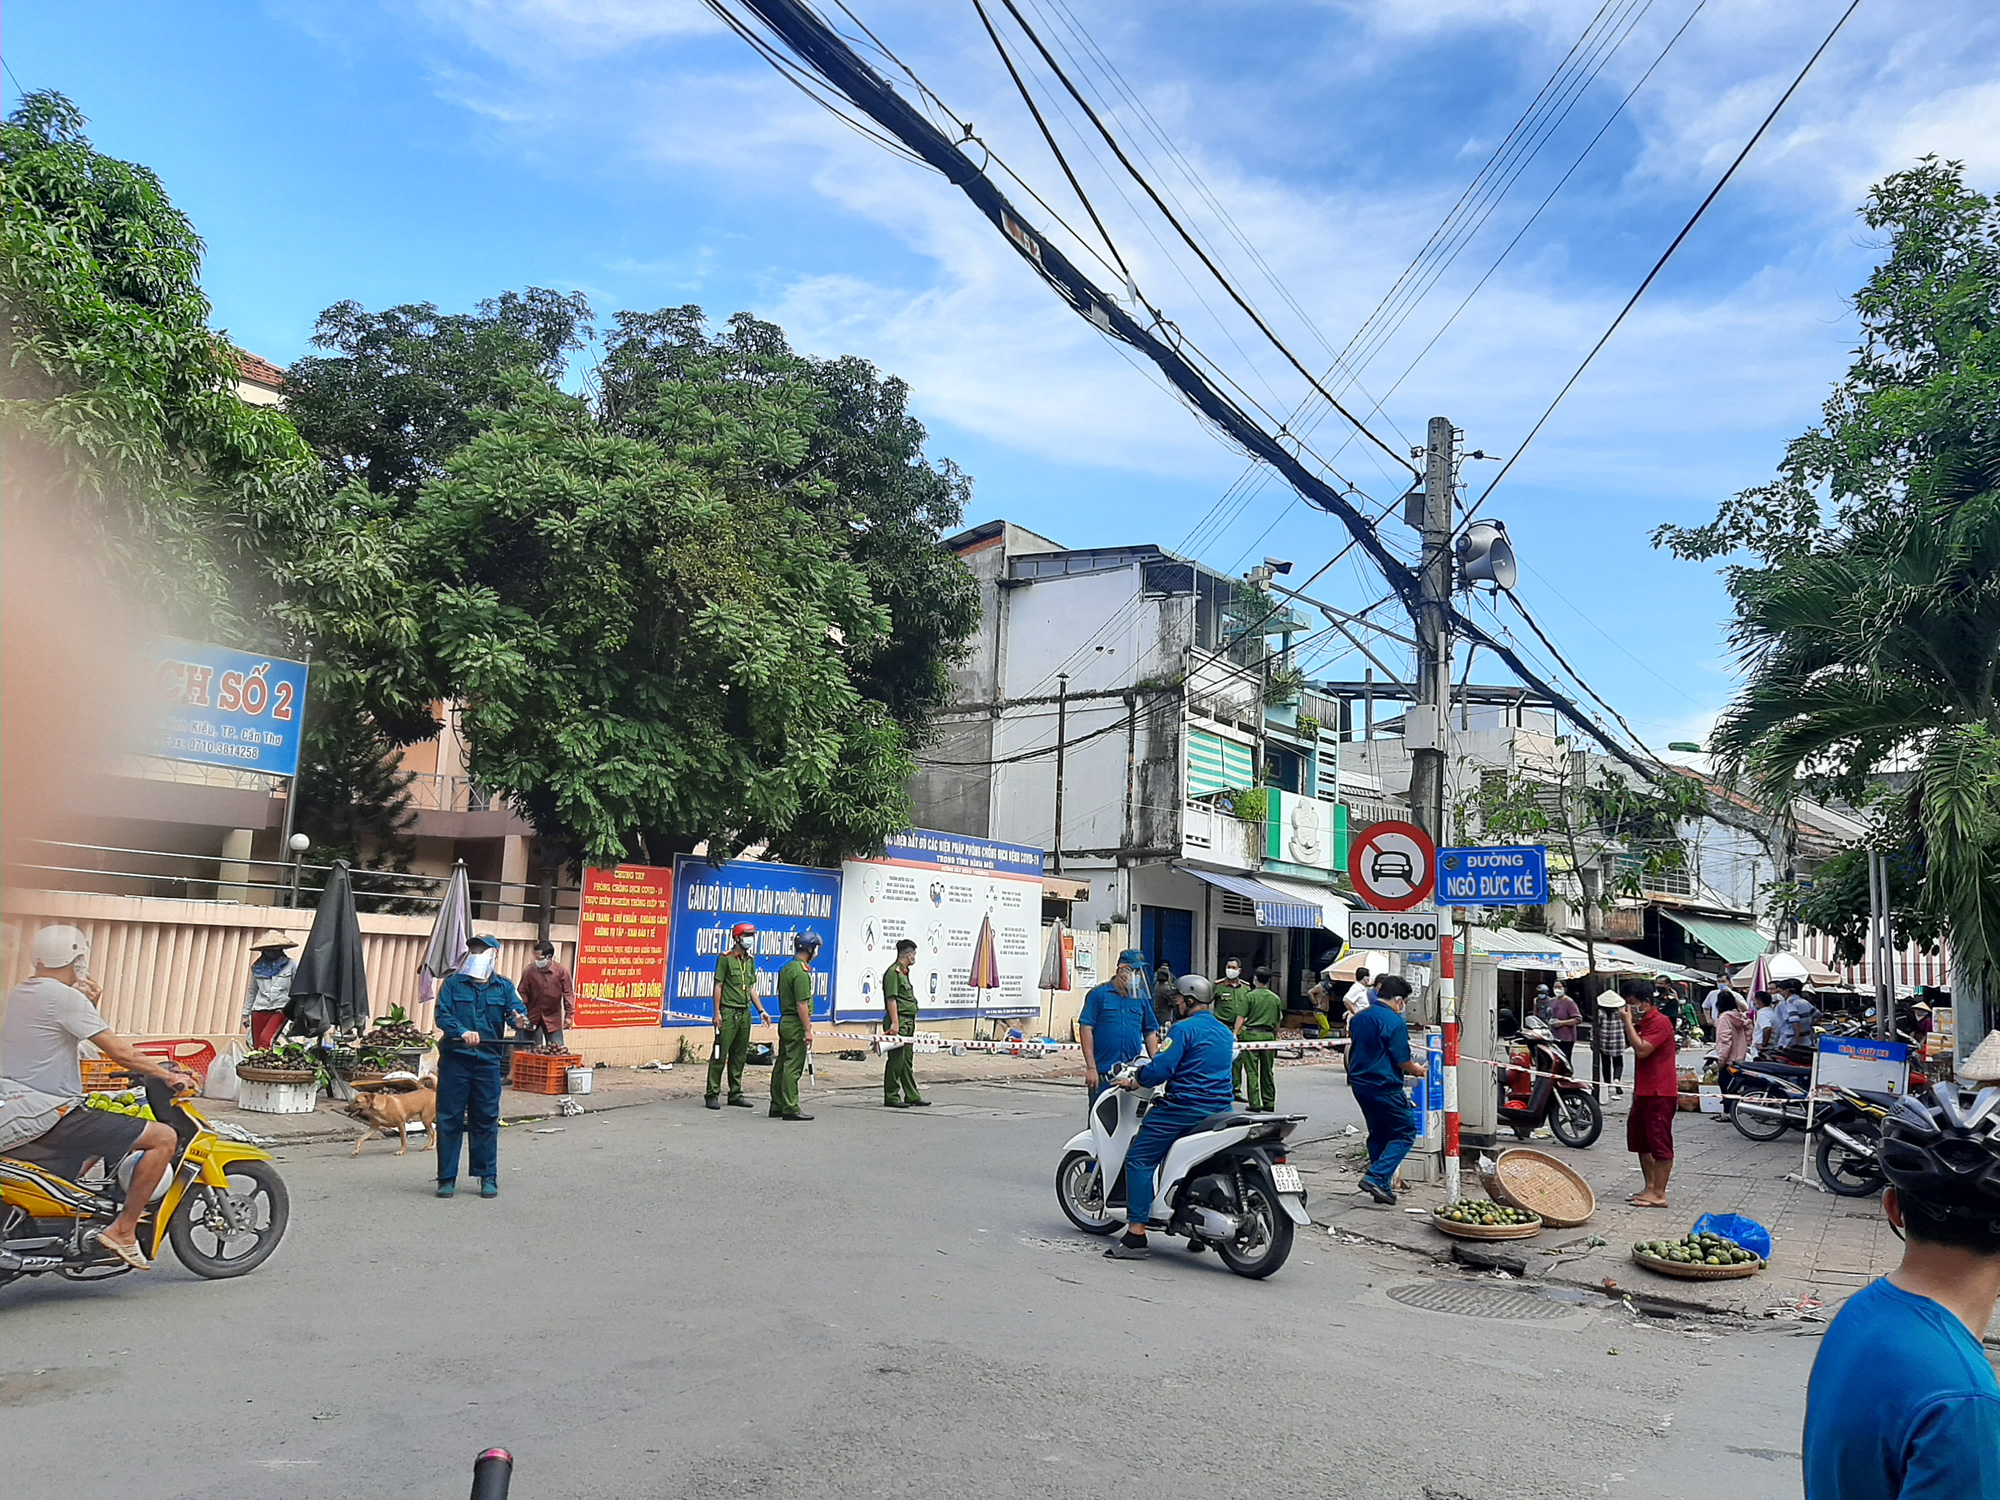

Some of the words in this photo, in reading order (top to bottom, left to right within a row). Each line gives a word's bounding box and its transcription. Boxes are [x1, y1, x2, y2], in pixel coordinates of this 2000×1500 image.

[218, 661, 270, 715] SỐ
[272, 681, 294, 720] 2
[222, 726, 238, 740] TP.
[242, 727, 260, 743] Cần
[264, 732, 282, 746] Thơ
[189, 739, 258, 759] 0710.3814258
[928, 836, 939, 851] CÁC
[1467, 852, 1524, 868] ĐƯỜNG
[1447, 871, 1476, 897] NGÔ
[1480, 870, 1510, 897] ĐỨC
[1514, 869, 1533, 896] KẾ
[688, 879, 707, 911] CÁN
[707, 881, 720, 917] BỘ
[733, 883, 757, 914] NHÂN
[757, 885, 774, 915] DÂN
[774, 886, 804, 917] PHƯỜNG
[806, 889, 820, 917] TÂN
[820, 894, 832, 918] AN
[696, 920, 723, 956] QUYẾT
[760, 928, 782, 961] DỰNG
[1351, 921, 1437, 941] 6:00-18:00
[626, 982, 630, 998] 3
[677, 966, 696, 998] VĂN
[696, 971, 715, 997] MIN
[817, 972, 829, 1000] THỊ
